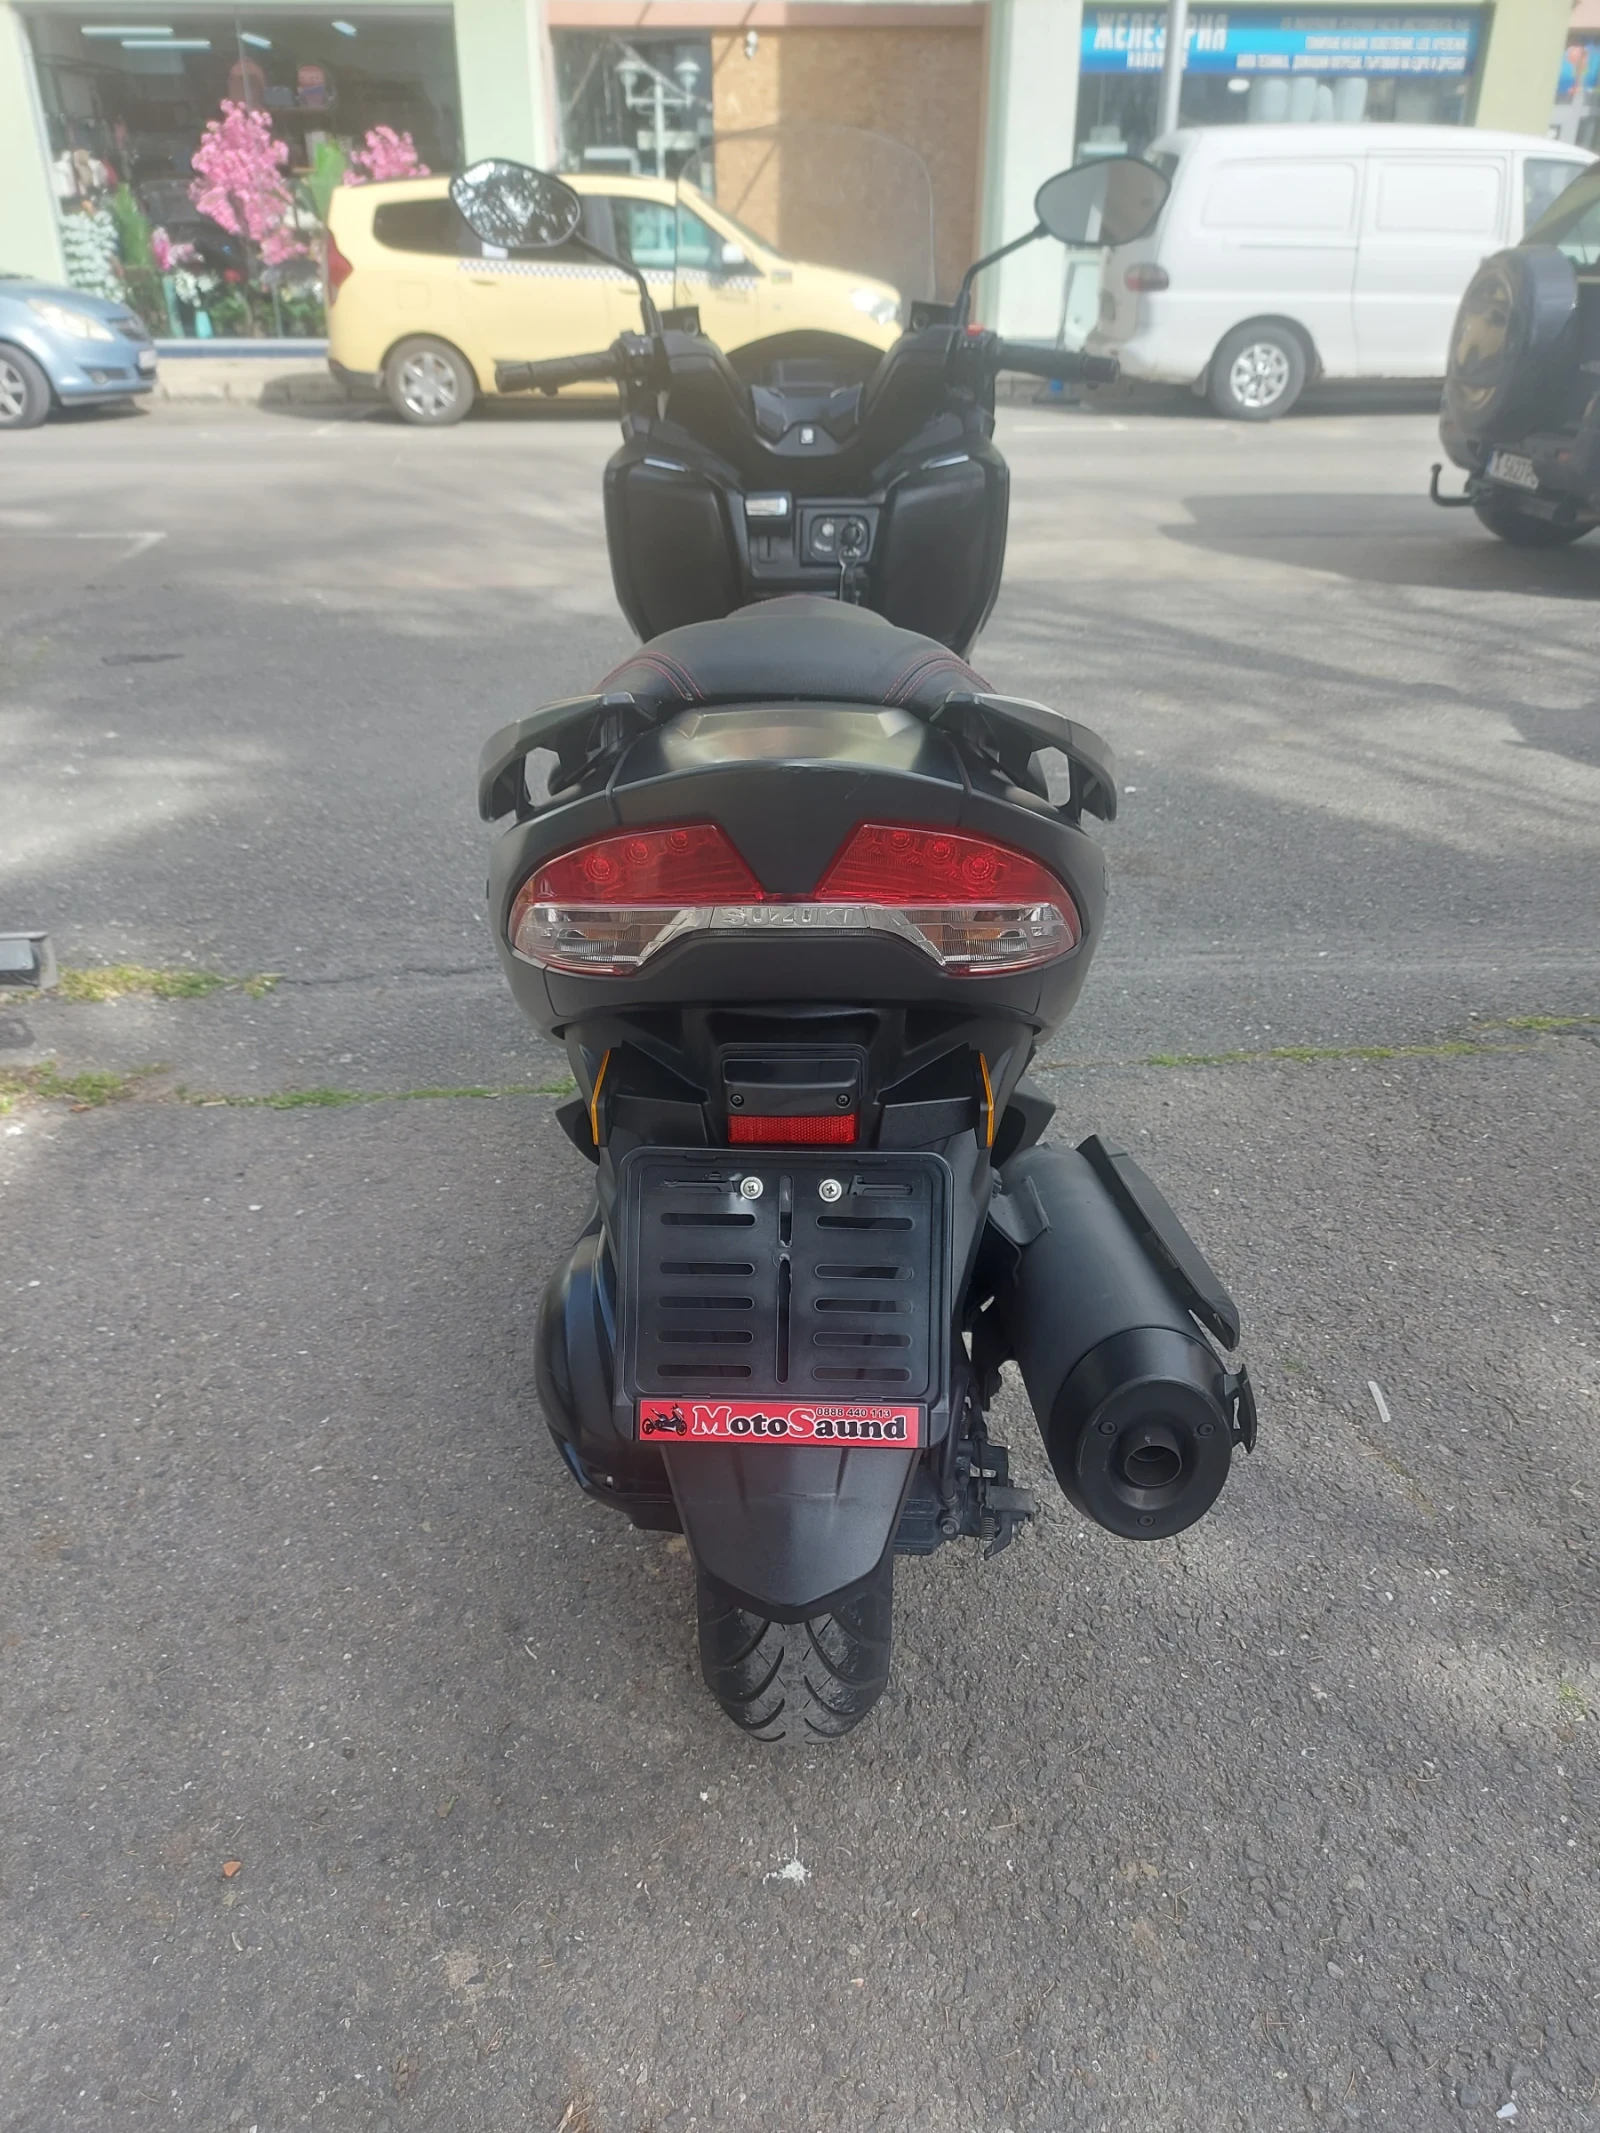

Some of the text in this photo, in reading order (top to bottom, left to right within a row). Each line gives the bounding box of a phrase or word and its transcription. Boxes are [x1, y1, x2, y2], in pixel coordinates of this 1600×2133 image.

[1093, 12, 1229, 51] ЖЕЛЕЗРИЯ
[721, 907, 855, 926] SUZUKI
[691, 1405, 906, 1440] MotoSaund
[816, 1407, 891, 1418] 0888 440 113
